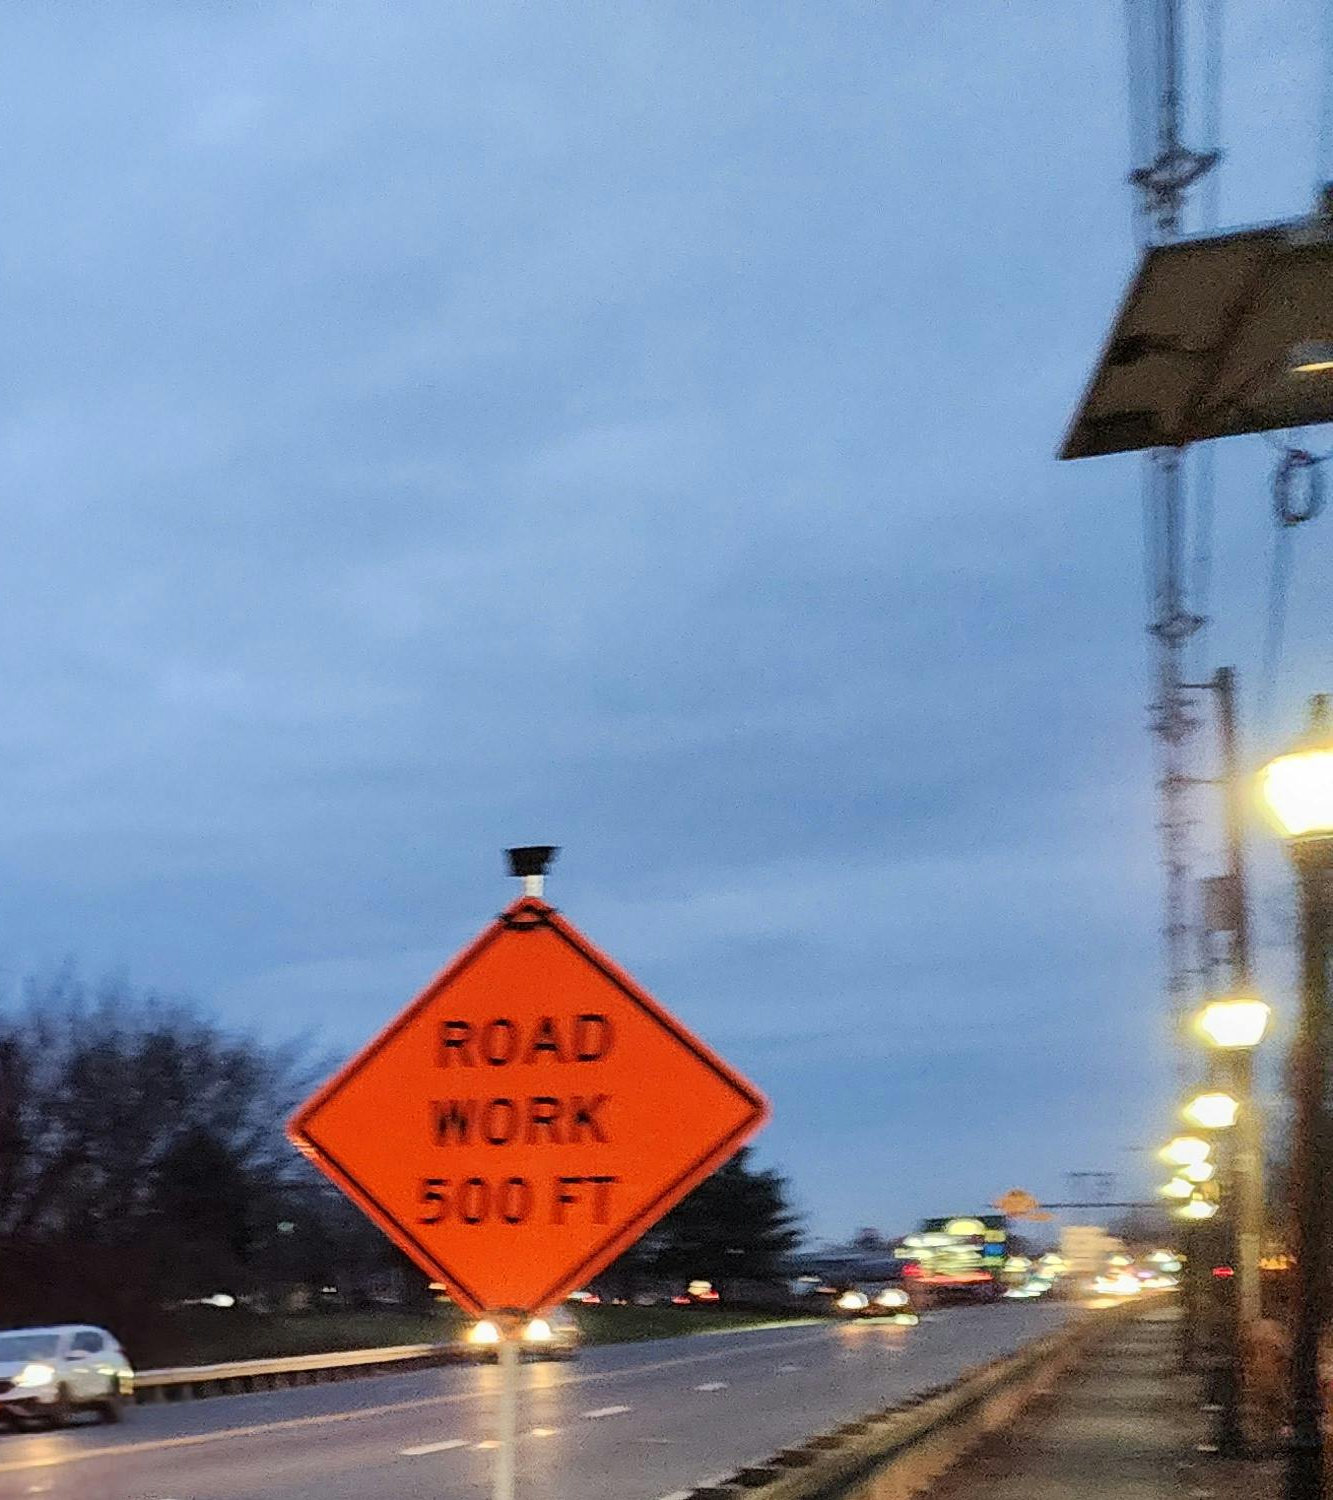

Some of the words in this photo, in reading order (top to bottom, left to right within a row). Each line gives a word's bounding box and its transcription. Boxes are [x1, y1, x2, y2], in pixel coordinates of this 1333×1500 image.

[437, 1013, 611, 1068] ROAD
[433, 1095, 610, 1146] WORK
[418, 1177, 533, 1225] 500
[550, 1175, 620, 1225] FT
